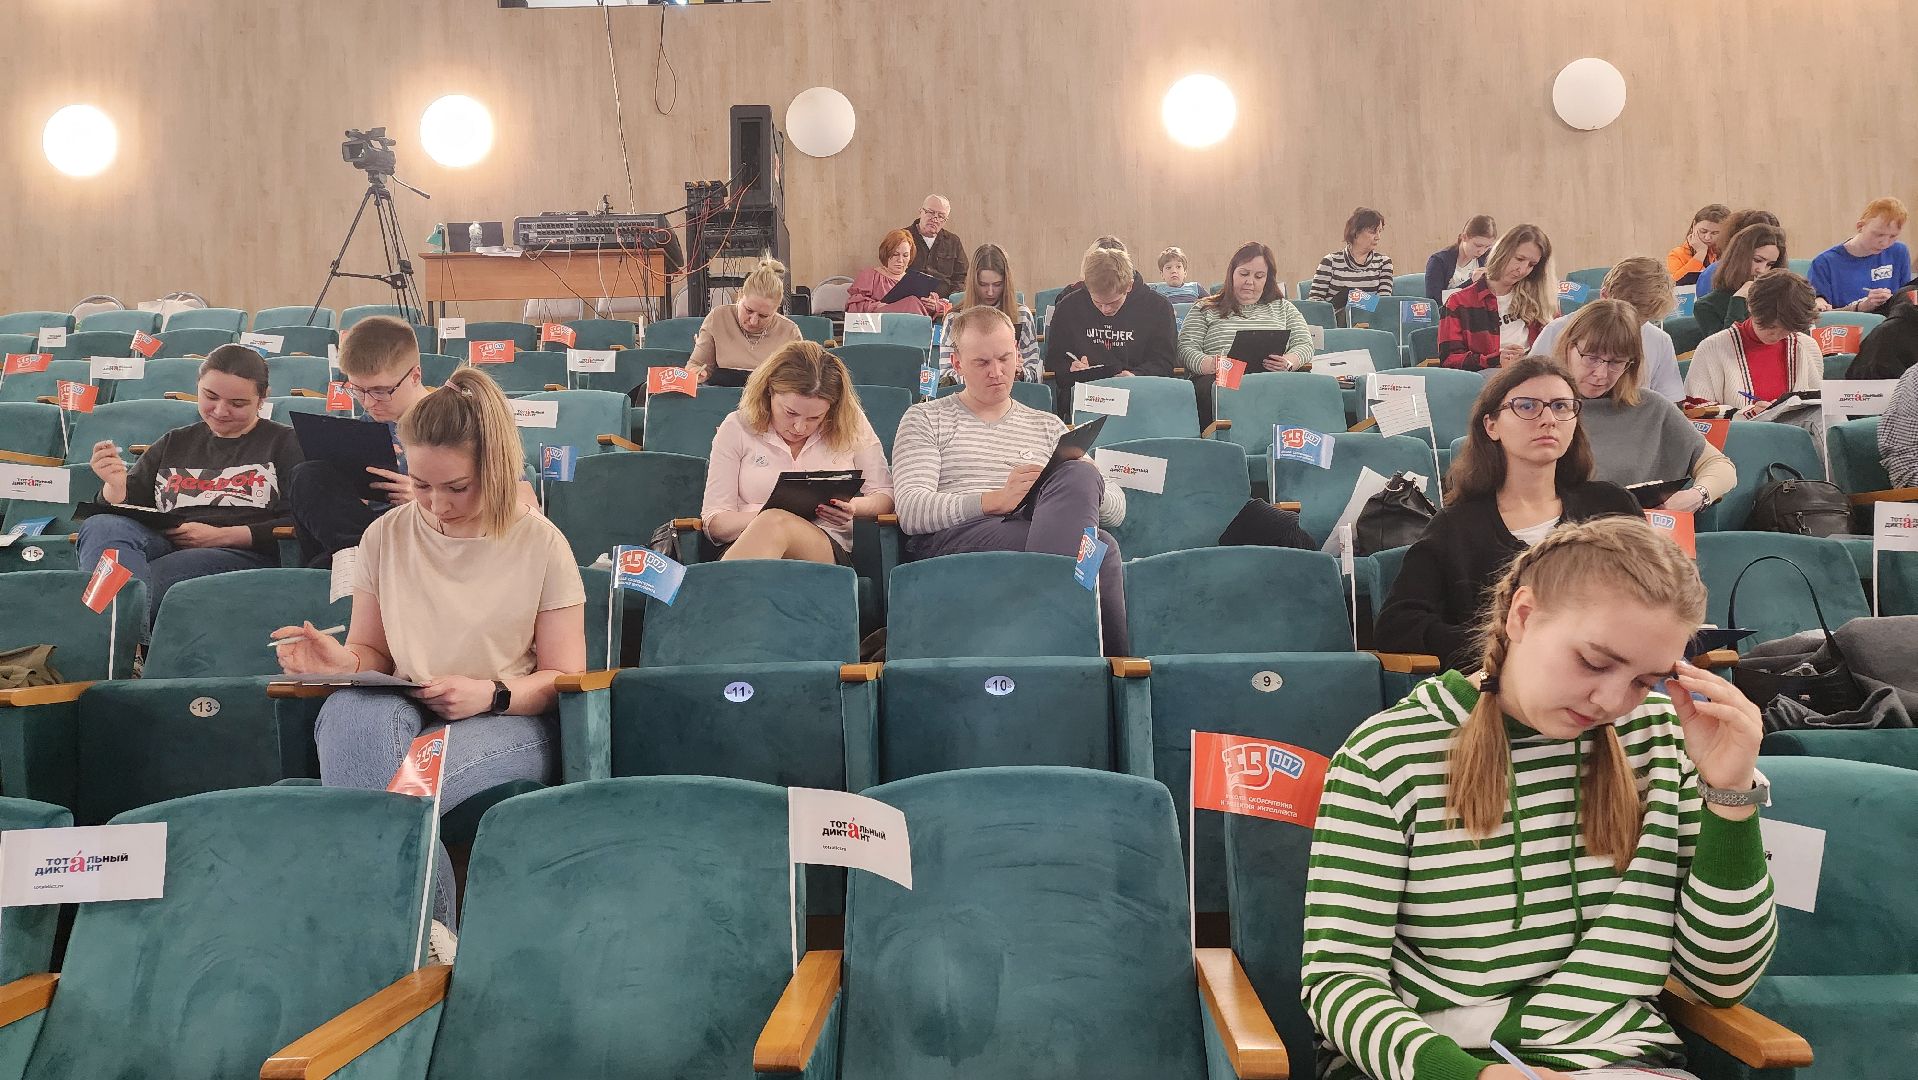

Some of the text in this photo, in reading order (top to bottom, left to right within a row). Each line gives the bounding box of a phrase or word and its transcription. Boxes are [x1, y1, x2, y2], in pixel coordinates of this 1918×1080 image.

[1086, 328, 1135, 341] WITCHER
[165, 470, 266, 493] Reebok
[1653, 514, 1674, 527] 007
[28, 549, 39, 558] 15
[992, 679, 1007, 691] 10
[1263, 675, 1272, 687] 9
[732, 686, 746, 697] 11
[197, 701, 212, 712] 13
[1270, 751, 1302, 774] 007
